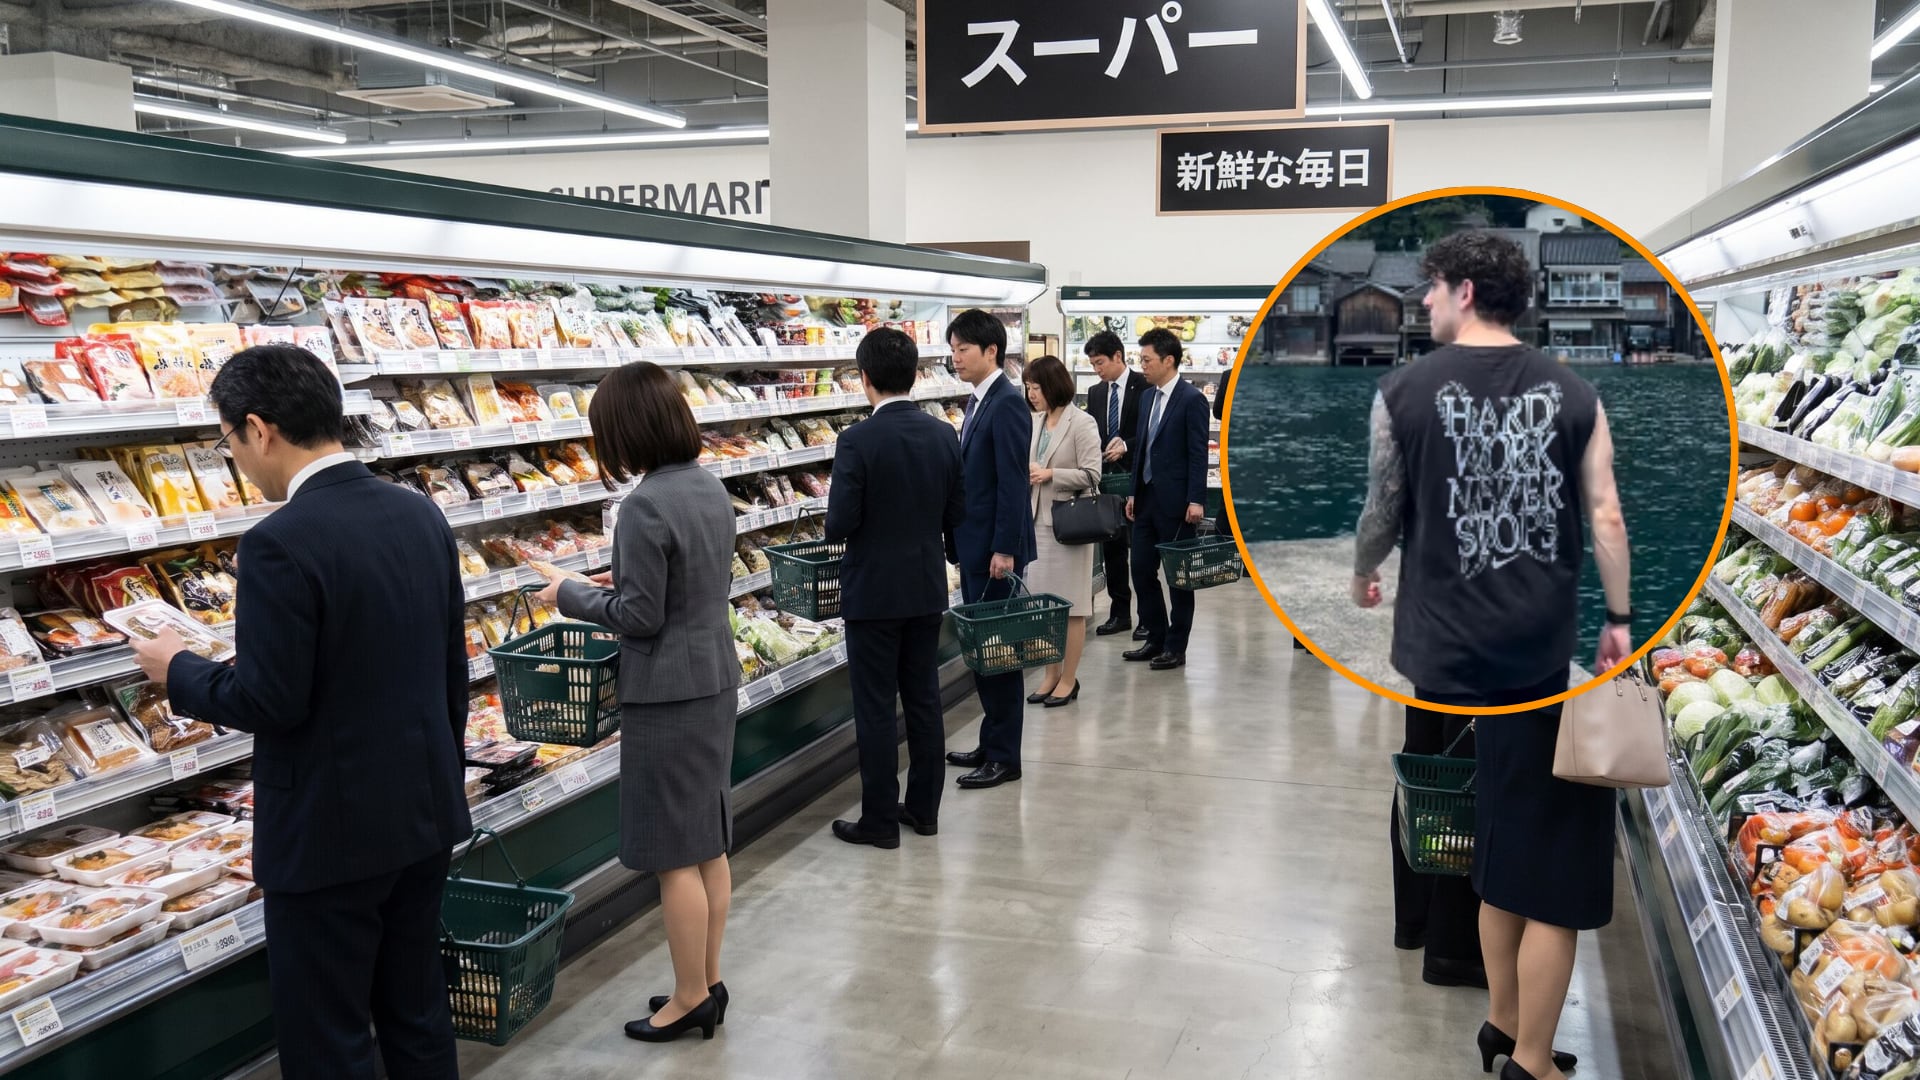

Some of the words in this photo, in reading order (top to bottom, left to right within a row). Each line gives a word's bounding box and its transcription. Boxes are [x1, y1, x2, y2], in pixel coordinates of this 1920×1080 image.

[961, 1, 1258, 88] スーパー
[1177, 148, 1370, 191] 新鮮な毎日
[1442, 392, 1553, 437] HARD
[1453, 431, 1557, 476] WORK
[1447, 470, 1564, 518] NEVER
[1456, 508, 1558, 557] STOPS
